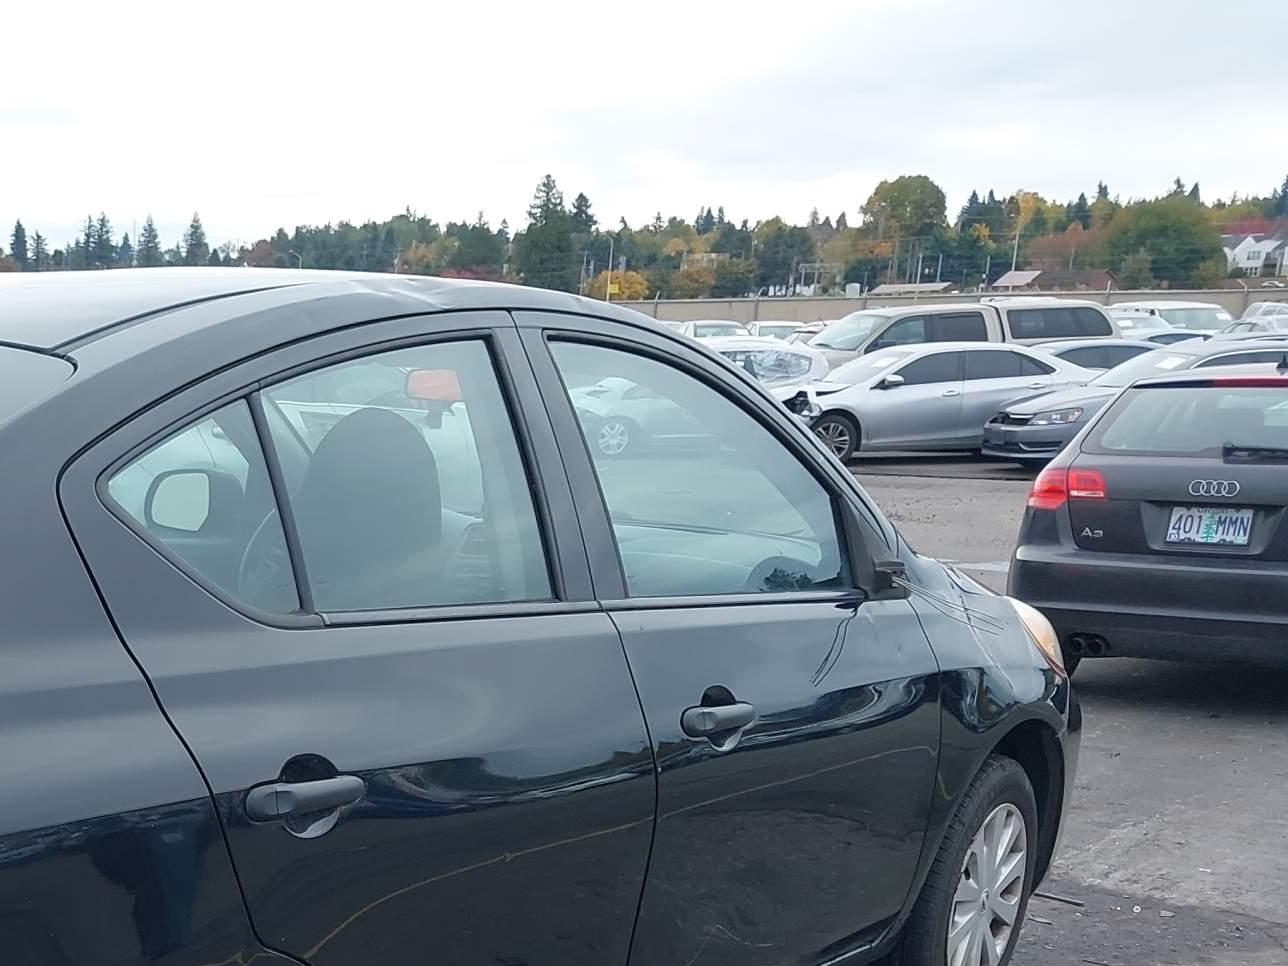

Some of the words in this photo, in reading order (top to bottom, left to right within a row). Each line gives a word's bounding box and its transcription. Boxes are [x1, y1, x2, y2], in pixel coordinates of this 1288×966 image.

[1081, 527, 1104, 538] A3
[1172, 514, 1202, 534] 401
[1215, 515, 1250, 537] MMN
